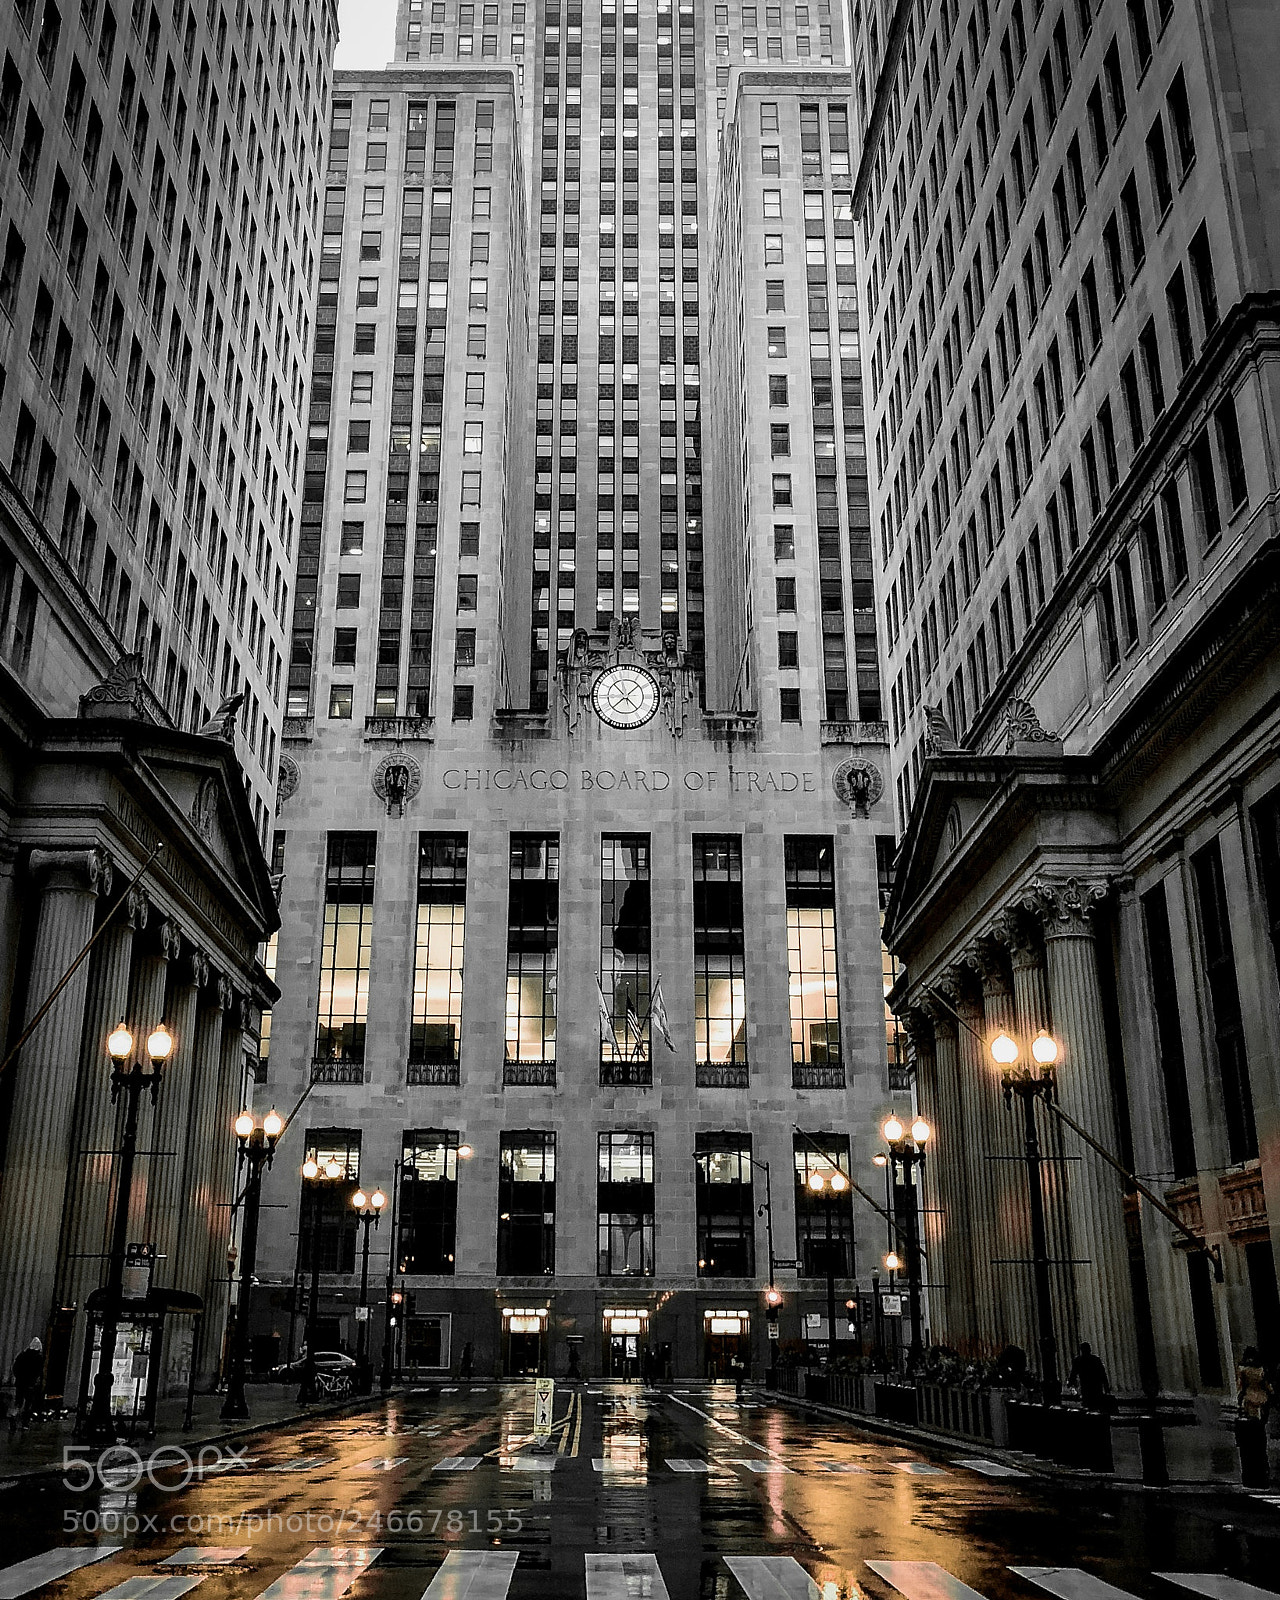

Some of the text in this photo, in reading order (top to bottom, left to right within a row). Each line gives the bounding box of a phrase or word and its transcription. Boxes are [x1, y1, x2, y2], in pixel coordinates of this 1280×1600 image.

[442, 769, 816, 792] CHICAGO BOARD OF TRADE
